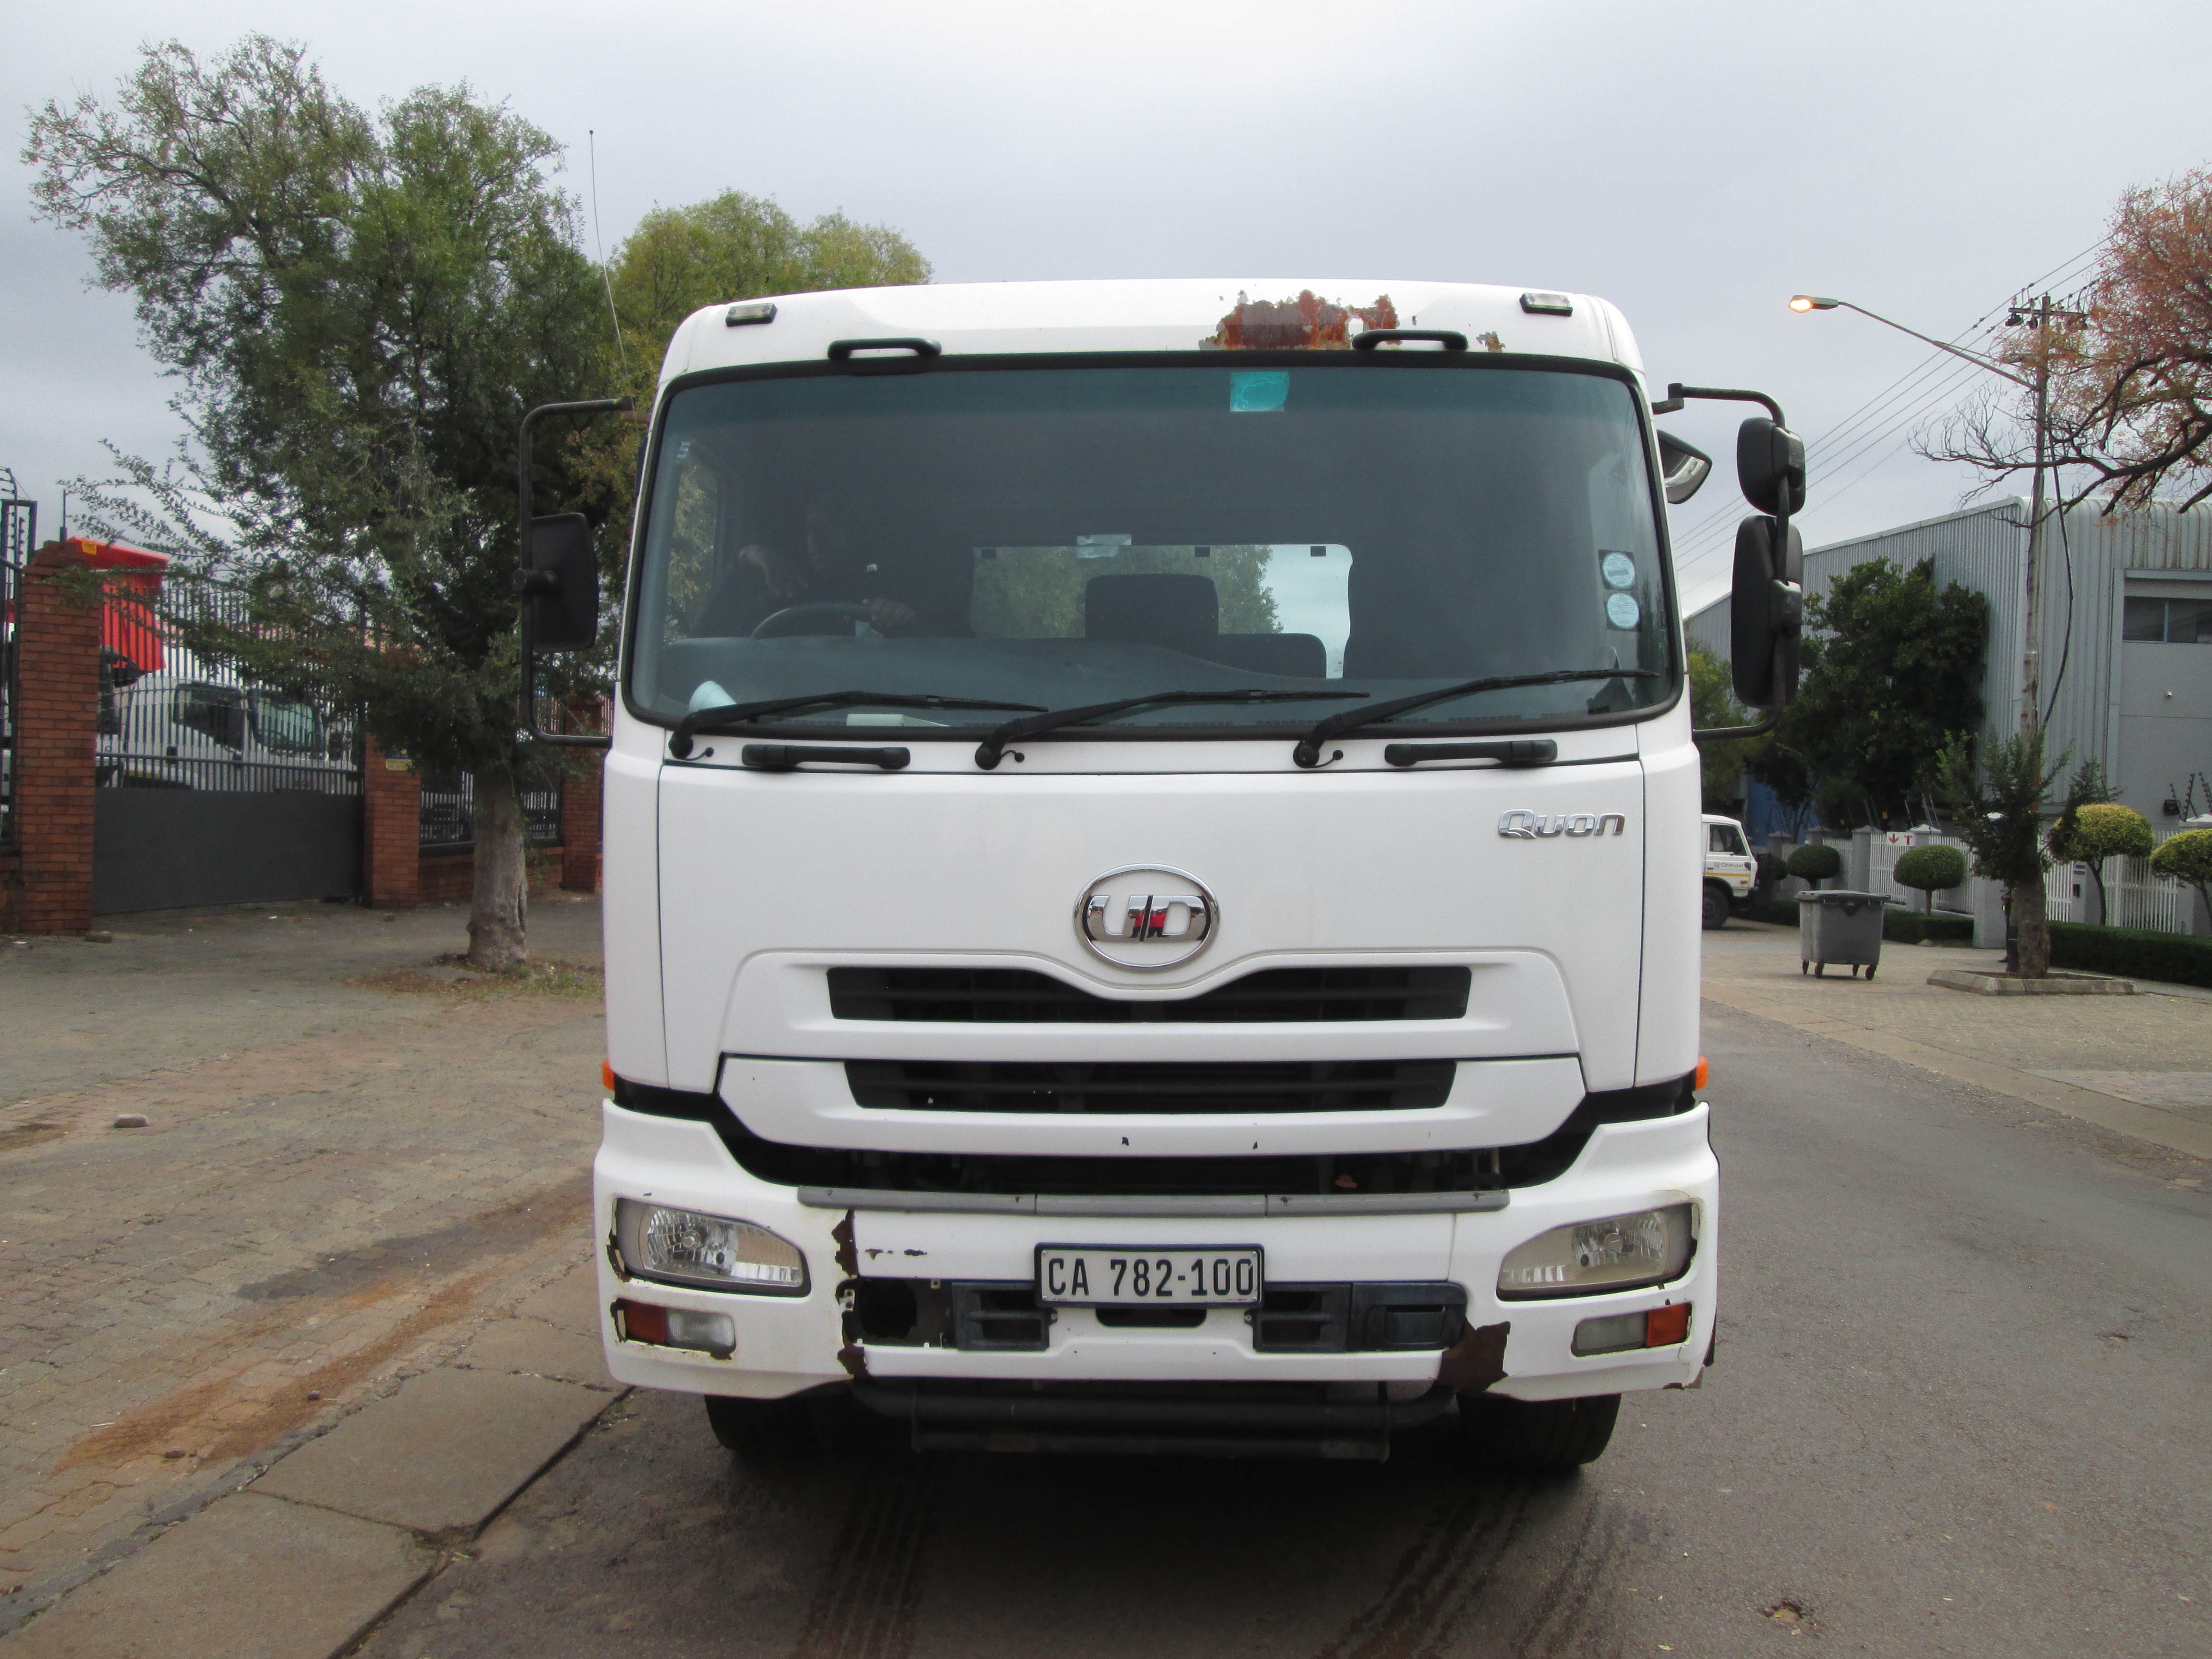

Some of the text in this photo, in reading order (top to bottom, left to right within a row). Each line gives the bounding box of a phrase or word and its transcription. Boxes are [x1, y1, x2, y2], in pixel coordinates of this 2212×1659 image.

[1497, 808, 1625, 839] Quon
[1086, 895, 1206, 942] UD
[1048, 1257, 1254, 1296] CA 782-100
